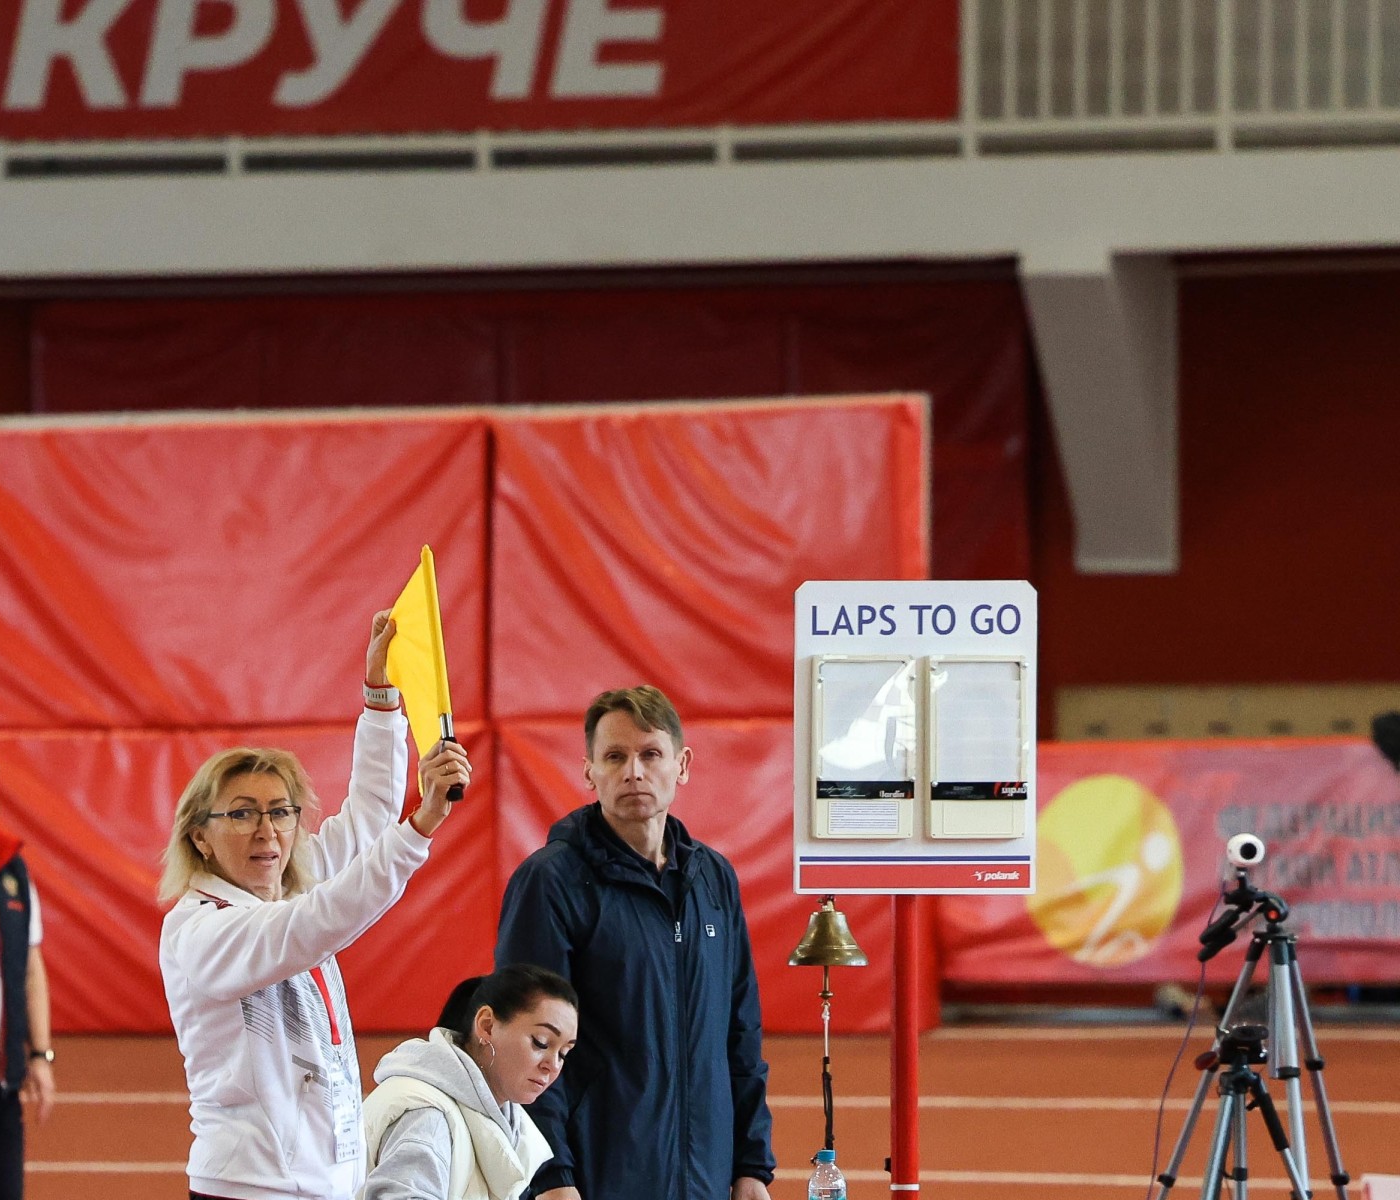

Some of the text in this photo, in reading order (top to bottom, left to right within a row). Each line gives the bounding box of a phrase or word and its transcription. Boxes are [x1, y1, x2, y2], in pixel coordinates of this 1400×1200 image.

[3, 0, 666, 110] КРУЧЕ
[811, 603, 1022, 636] LAPS TO GO
